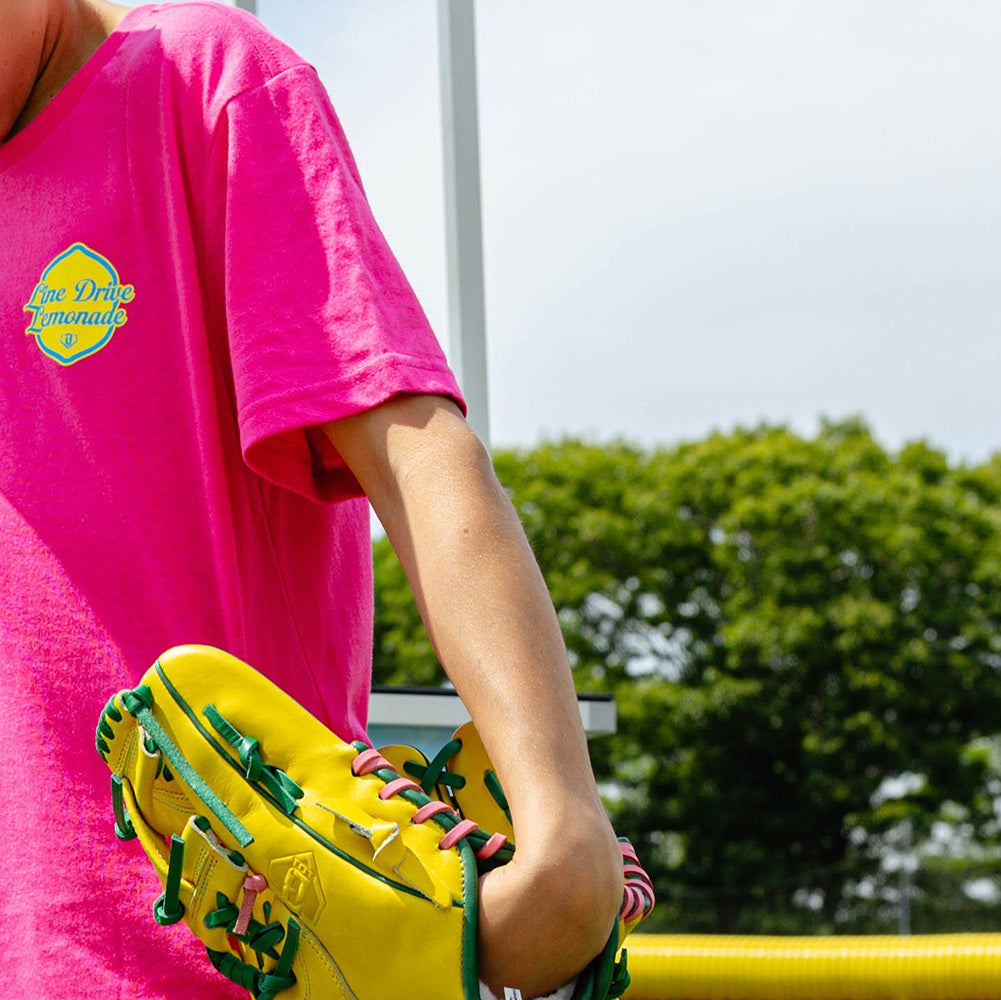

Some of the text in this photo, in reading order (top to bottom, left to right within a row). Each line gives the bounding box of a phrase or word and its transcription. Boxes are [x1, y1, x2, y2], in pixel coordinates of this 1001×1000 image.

[25, 278, 134, 309] Line Drive
[26, 300, 126, 333] Lemonade
